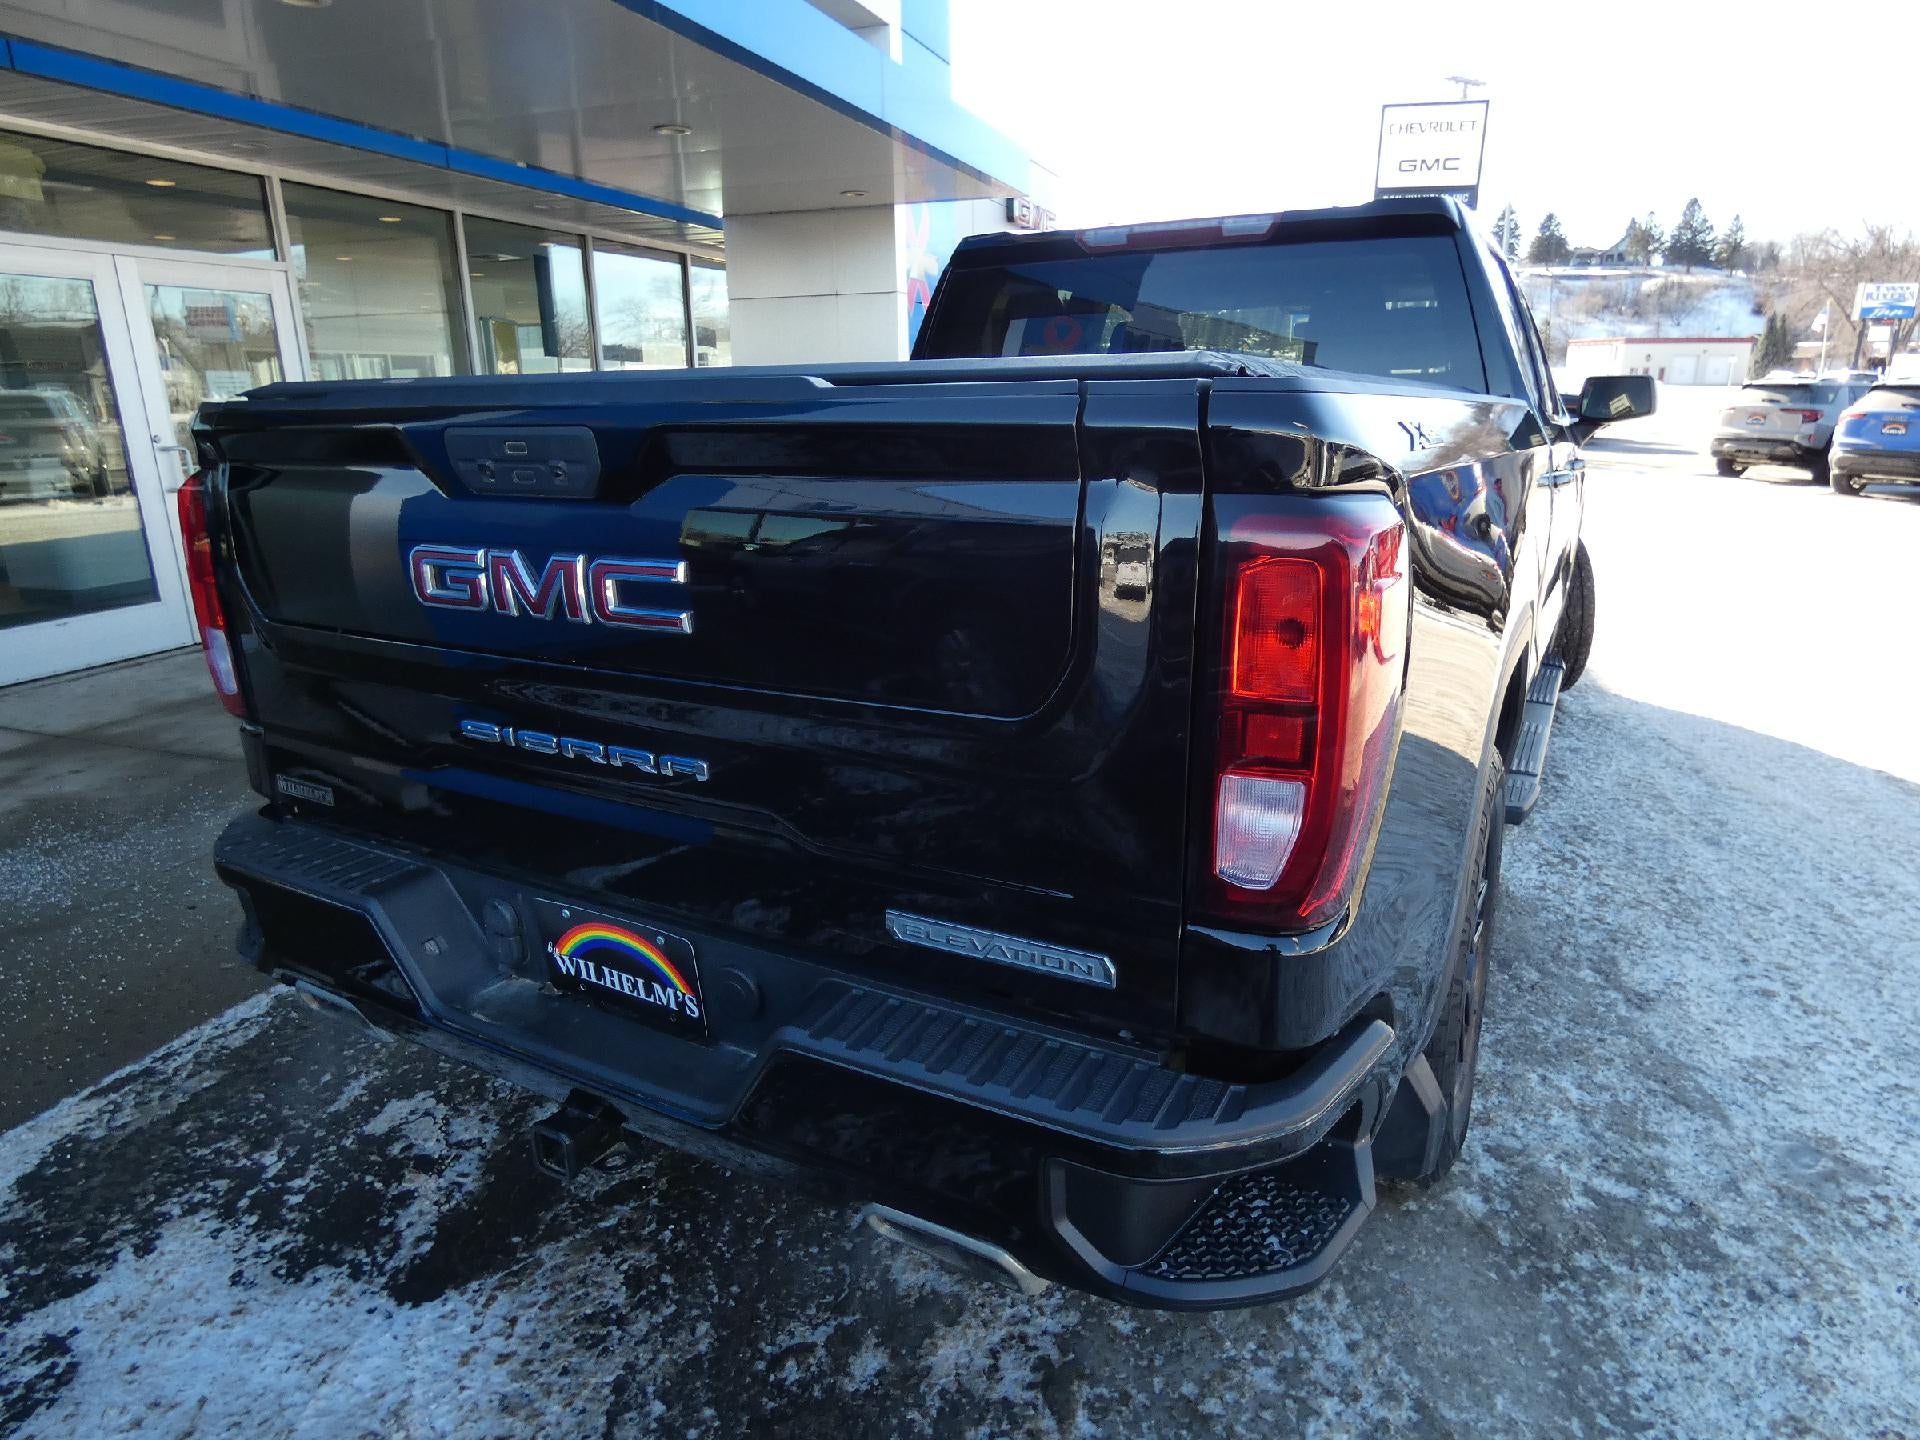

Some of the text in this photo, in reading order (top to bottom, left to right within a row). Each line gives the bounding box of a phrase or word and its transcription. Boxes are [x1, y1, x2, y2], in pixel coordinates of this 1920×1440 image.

[1398, 157, 1461, 173] GMC
[409, 543, 695, 634] GMC
[459, 719, 710, 782] SIERRA
[904, 922, 1095, 978] ELEVATION
[553, 953, 700, 1019] WILHELM'S
